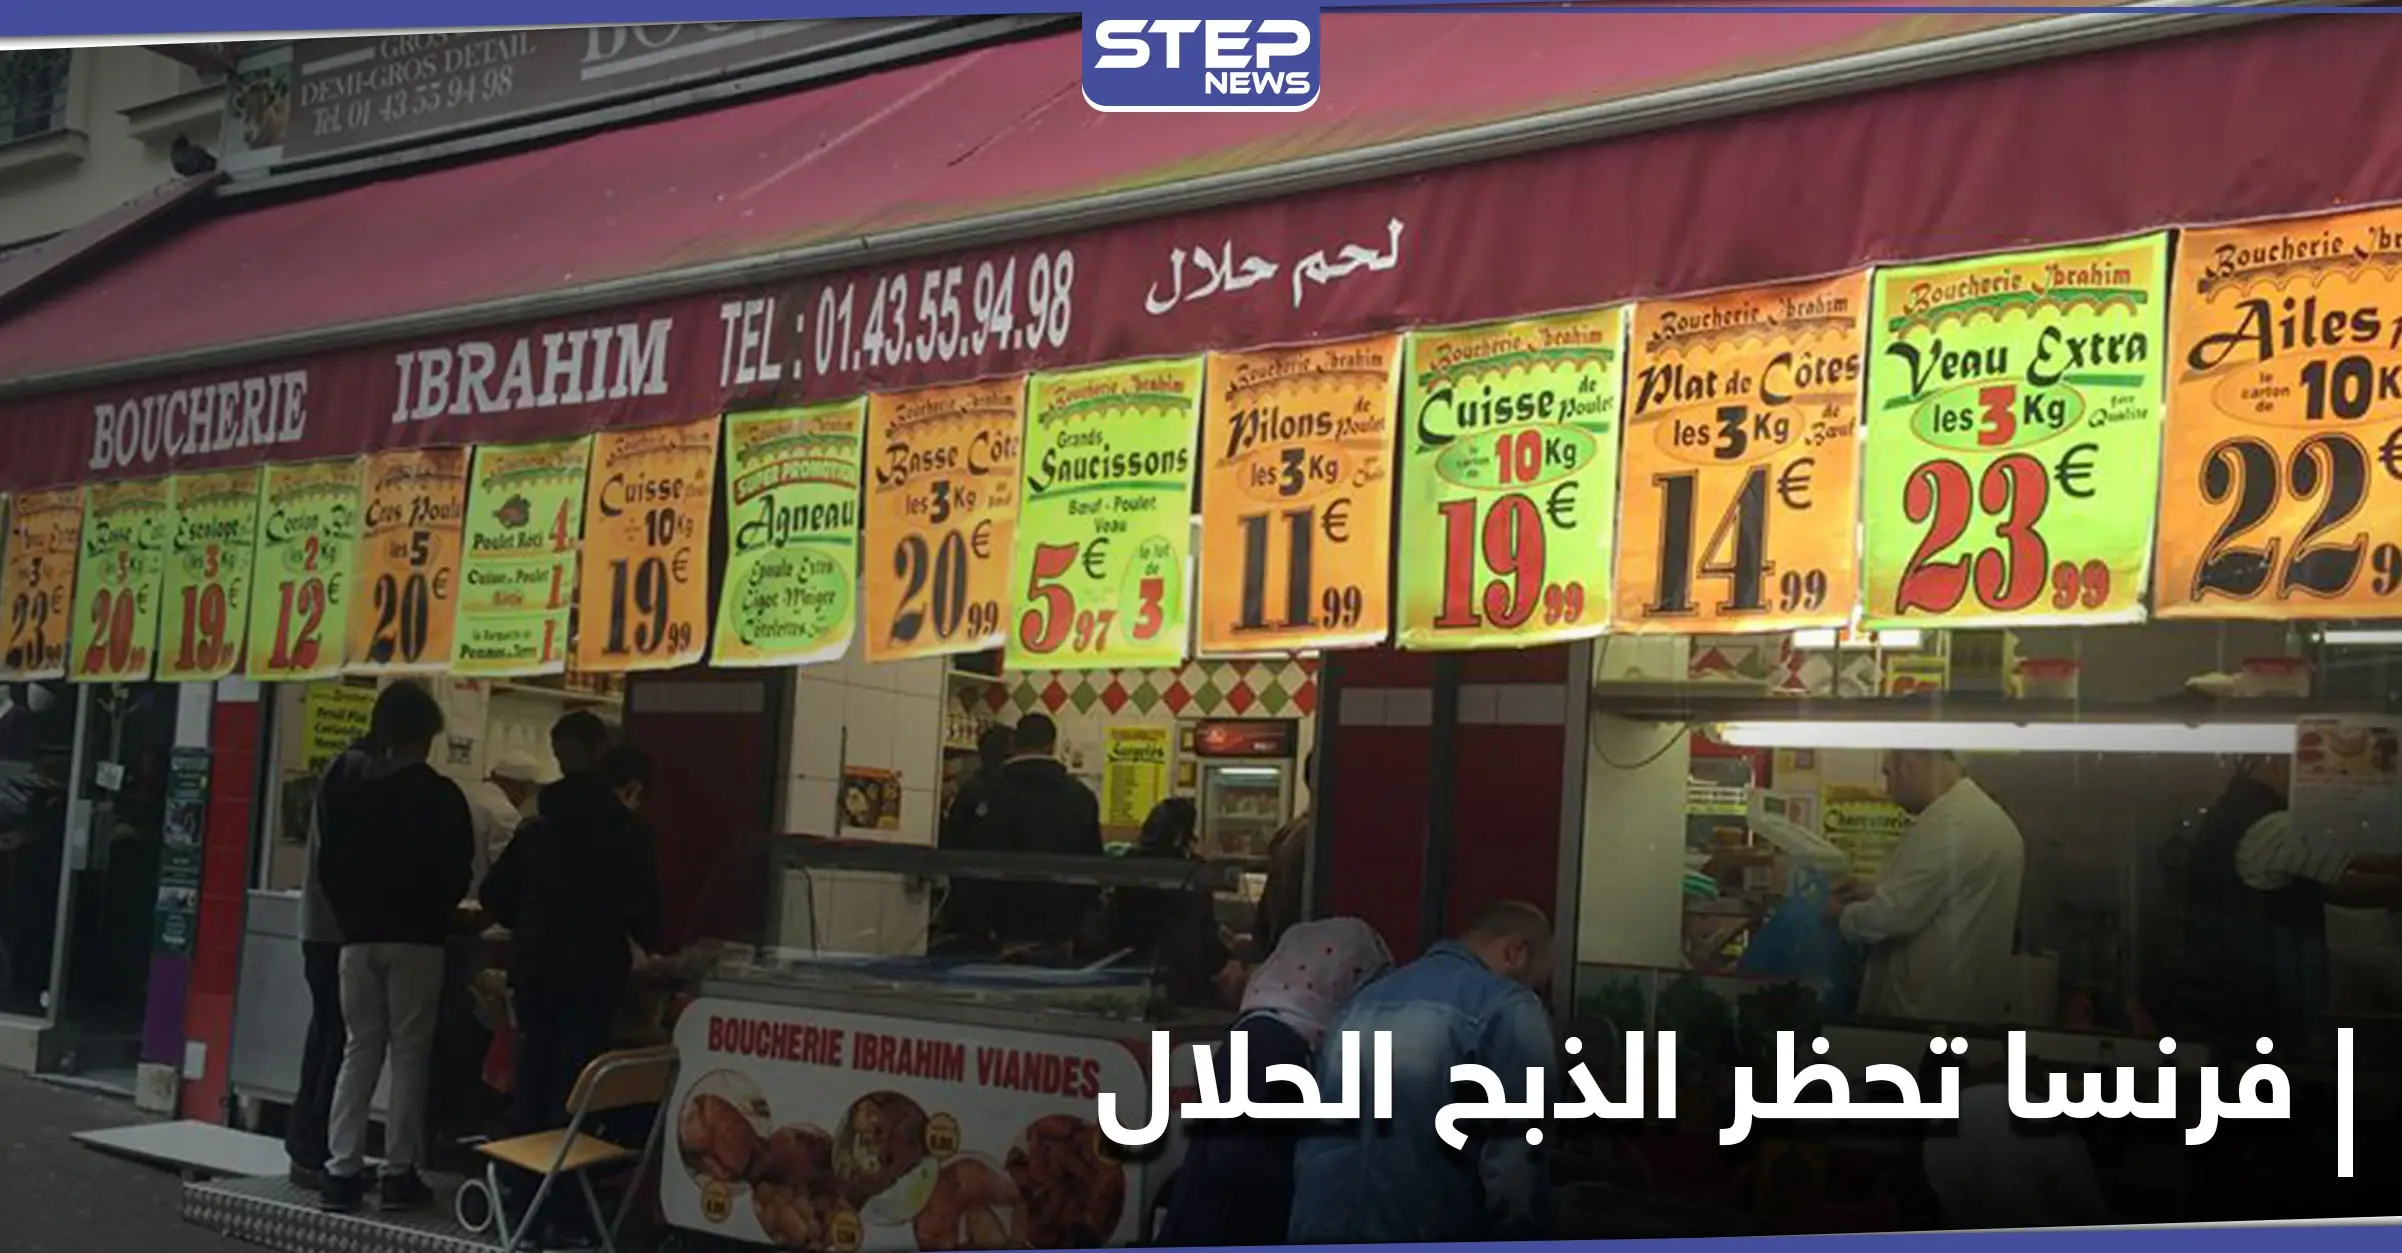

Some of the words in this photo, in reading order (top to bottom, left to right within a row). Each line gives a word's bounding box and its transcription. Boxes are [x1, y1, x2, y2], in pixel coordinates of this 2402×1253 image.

[301, 53, 438, 106] DEMI-GROS
[444, 32, 537, 72] DETAIL
[347, 100, 372, 128] 01
[379, 89, 408, 122] 43
[413, 81, 442, 114] 55
[482, 65, 514, 101] 98
[1145, 240, 1280, 316] حلال
[1292, 217, 1404, 308] لحم
[2204, 229, 2344, 279] Boucherie
[814, 249, 1075, 375] 01.43.55.94.98
[1903, 268, 2023, 315] Boucherie
[2031, 262, 2133, 296] Ibrahim
[1652, 305, 1761, 343] Boucherie
[1766, 296, 1849, 325] Ibrahim
[2187, 295, 2382, 371] Ailes
[1579, 376, 1597, 396] de
[1885, 338, 2008, 397] Veau
[2026, 325, 2149, 388] Extra
[2259, 371, 2274, 384] le
[2299, 354, 2374, 421] 10
[89, 371, 309, 470] BOUCHERIE
[392, 318, 671, 424] IBRAHIM
[1634, 363, 1717, 415] Plat
[1725, 370, 1752, 396] de
[1823, 403, 1841, 419] de
[2241, 385, 2290, 400] carton
[2255, 399, 2274, 413] de
[1056, 427, 1103, 448] Grands
[1226, 405, 1333, 459] Pilons
[1416, 387, 1555, 448] Cuisse
[1673, 417, 1710, 447] les
[1714, 405, 1749, 461] 3
[1754, 413, 1790, 446] Kg
[1933, 401, 1975, 436] les
[1977, 385, 2017, 448] 3
[2022, 392, 2066, 430] Kg
[875, 441, 958, 487] Basse
[1028, 445, 1188, 493] Saucissons
[1250, 462, 1277, 487] les
[1279, 447, 1305, 497] 3
[1308, 454, 1339, 483] Kg
[1495, 429, 1542, 484] 10
[1545, 437, 1577, 472] Kg
[2054, 442, 2101, 499] €
[600, 472, 684, 518] Cuisse
[905, 494, 929, 515] les
[929, 480, 950, 524] 3
[954, 486, 977, 512] Kg
[1113, 494, 1157, 514] Poulet
[1546, 480, 1580, 529] €
[1776, 457, 1816, 511] €
[549, 496, 569, 554] 4
[646, 506, 676, 547] 10
[678, 512, 694, 538] Kg
[736, 494, 853, 551] Agneau
[970, 519, 992, 559] €
[1094, 515, 1127, 534] Veau
[1322, 497, 1353, 543] €
[1641, 463, 1777, 618] 14
[1895, 452, 2050, 616] 23
[2190, 431, 2372, 602] 22
[409, 530, 430, 566] 5
[672, 548, 691, 583] €
[1082, 536, 1110, 580] €
[1145, 561, 1160, 576] de
[1229, 504, 1321, 635] 11
[1433, 493, 1547, 629] 19
[602, 556, 669, 656] 19
[892, 528, 968, 646] 20
[1018, 541, 1080, 653] 5
[1132, 577, 1165, 640] 3
[1322, 585, 1362, 629] 99
[1542, 581, 1585, 626] 99
[1780, 569, 1828, 613] 99
[2051, 559, 2112, 611] 99
[82, 587, 134, 674] 20
[174, 582, 226, 671] 19
[268, 577, 325, 671] 12
[365, 573, 429, 664] 20
[432, 567, 450, 599] €
[667, 621, 692, 654] 99
[967, 601, 999, 639] 99
[1074, 608, 1119, 653] 97
[708, 1016, 844, 1068] BOUCHERIE
[853, 1031, 965, 1084] IBRAHIM
[976, 1046, 1100, 1100] VIANDES
